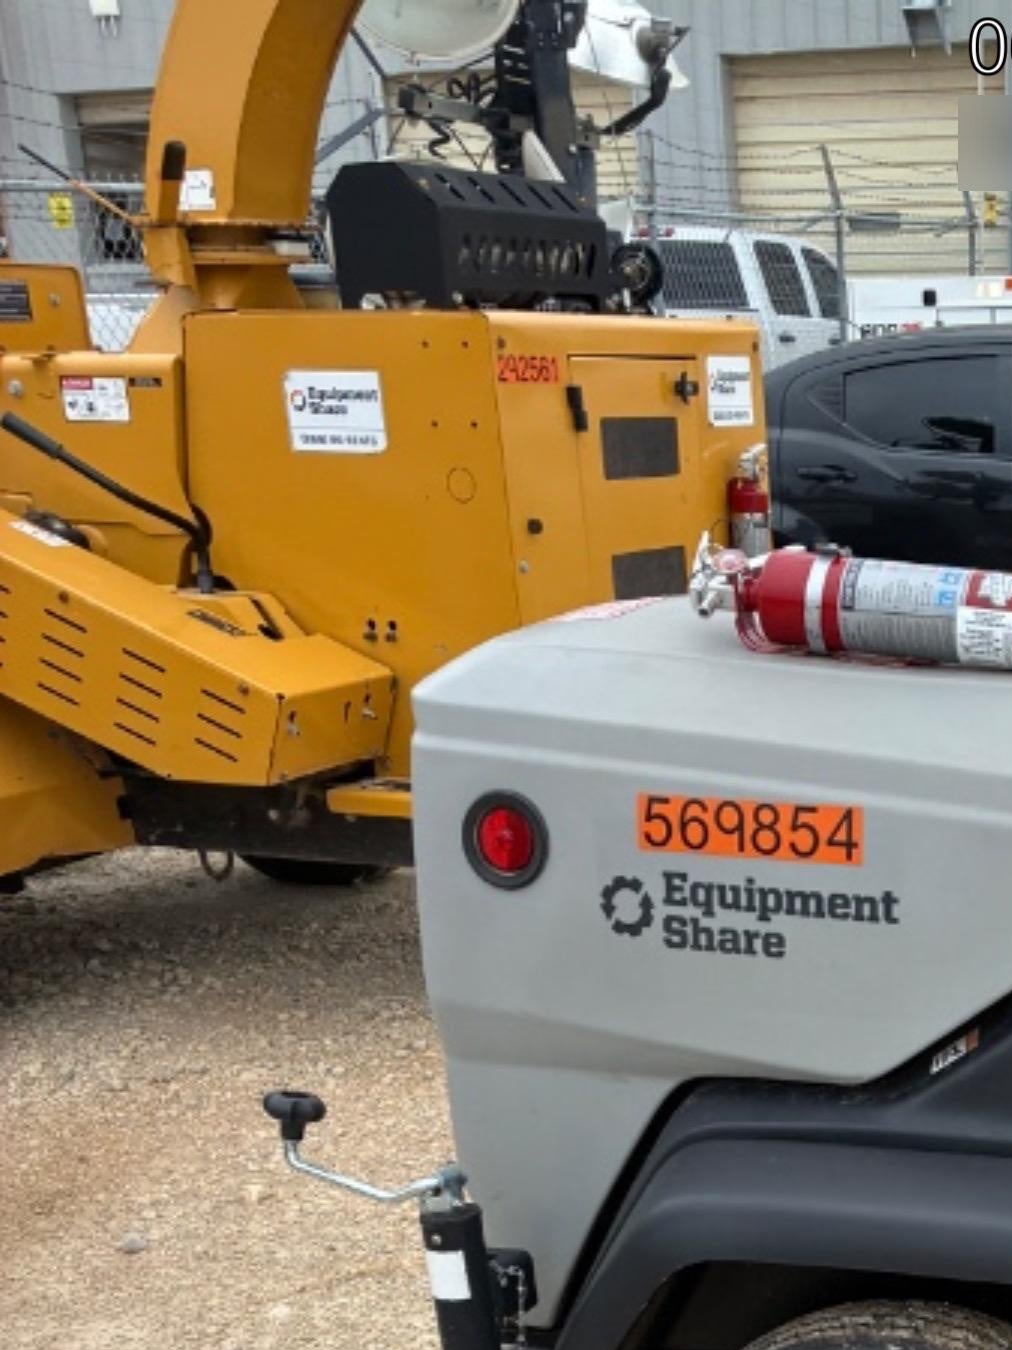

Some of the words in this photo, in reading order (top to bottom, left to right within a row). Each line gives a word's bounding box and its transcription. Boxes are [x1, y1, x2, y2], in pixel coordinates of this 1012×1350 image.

[643, 795, 860, 861] 569854
[661, 870, 900, 924] Equipment
[661, 914, 786, 958] Share
